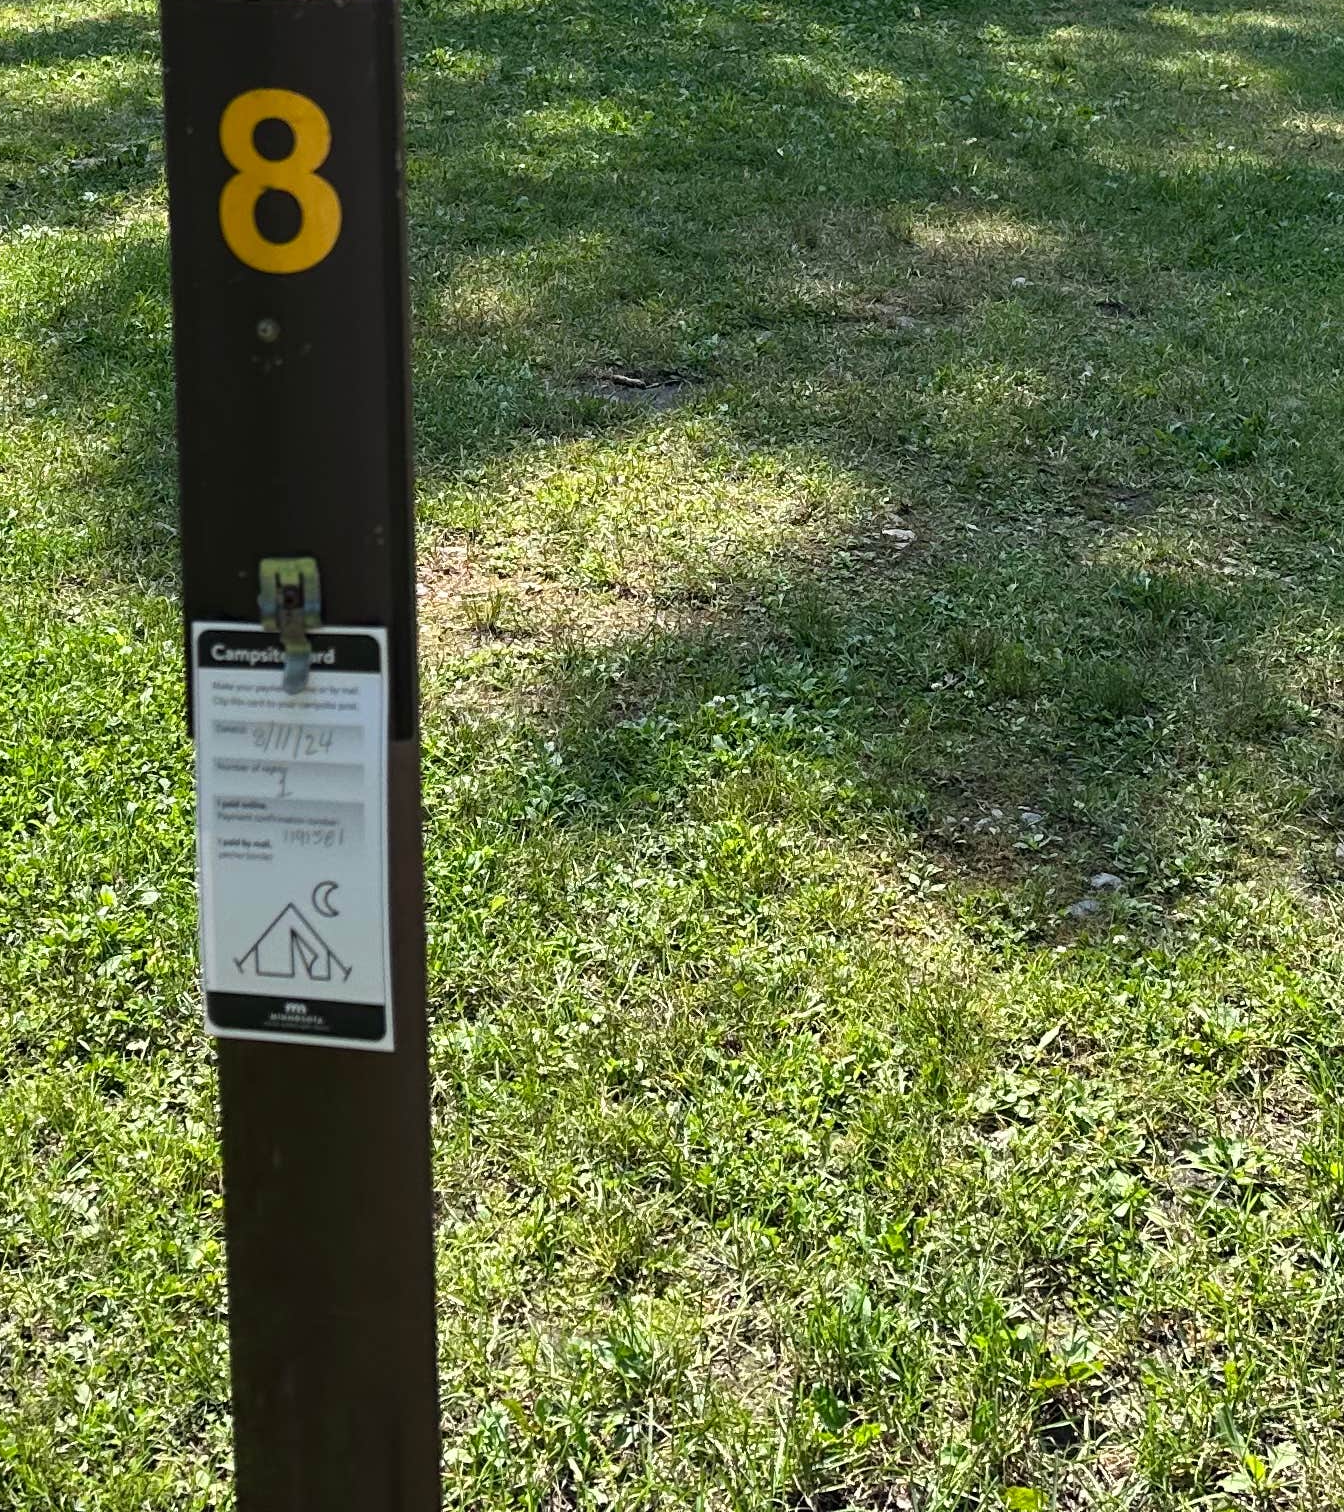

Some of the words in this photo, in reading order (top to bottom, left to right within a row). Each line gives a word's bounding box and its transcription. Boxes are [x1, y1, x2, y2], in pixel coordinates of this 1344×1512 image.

[218, 88, 343, 275] 8
[309, 648, 336, 665] ard
[253, 719, 335, 760] 8/11/24
